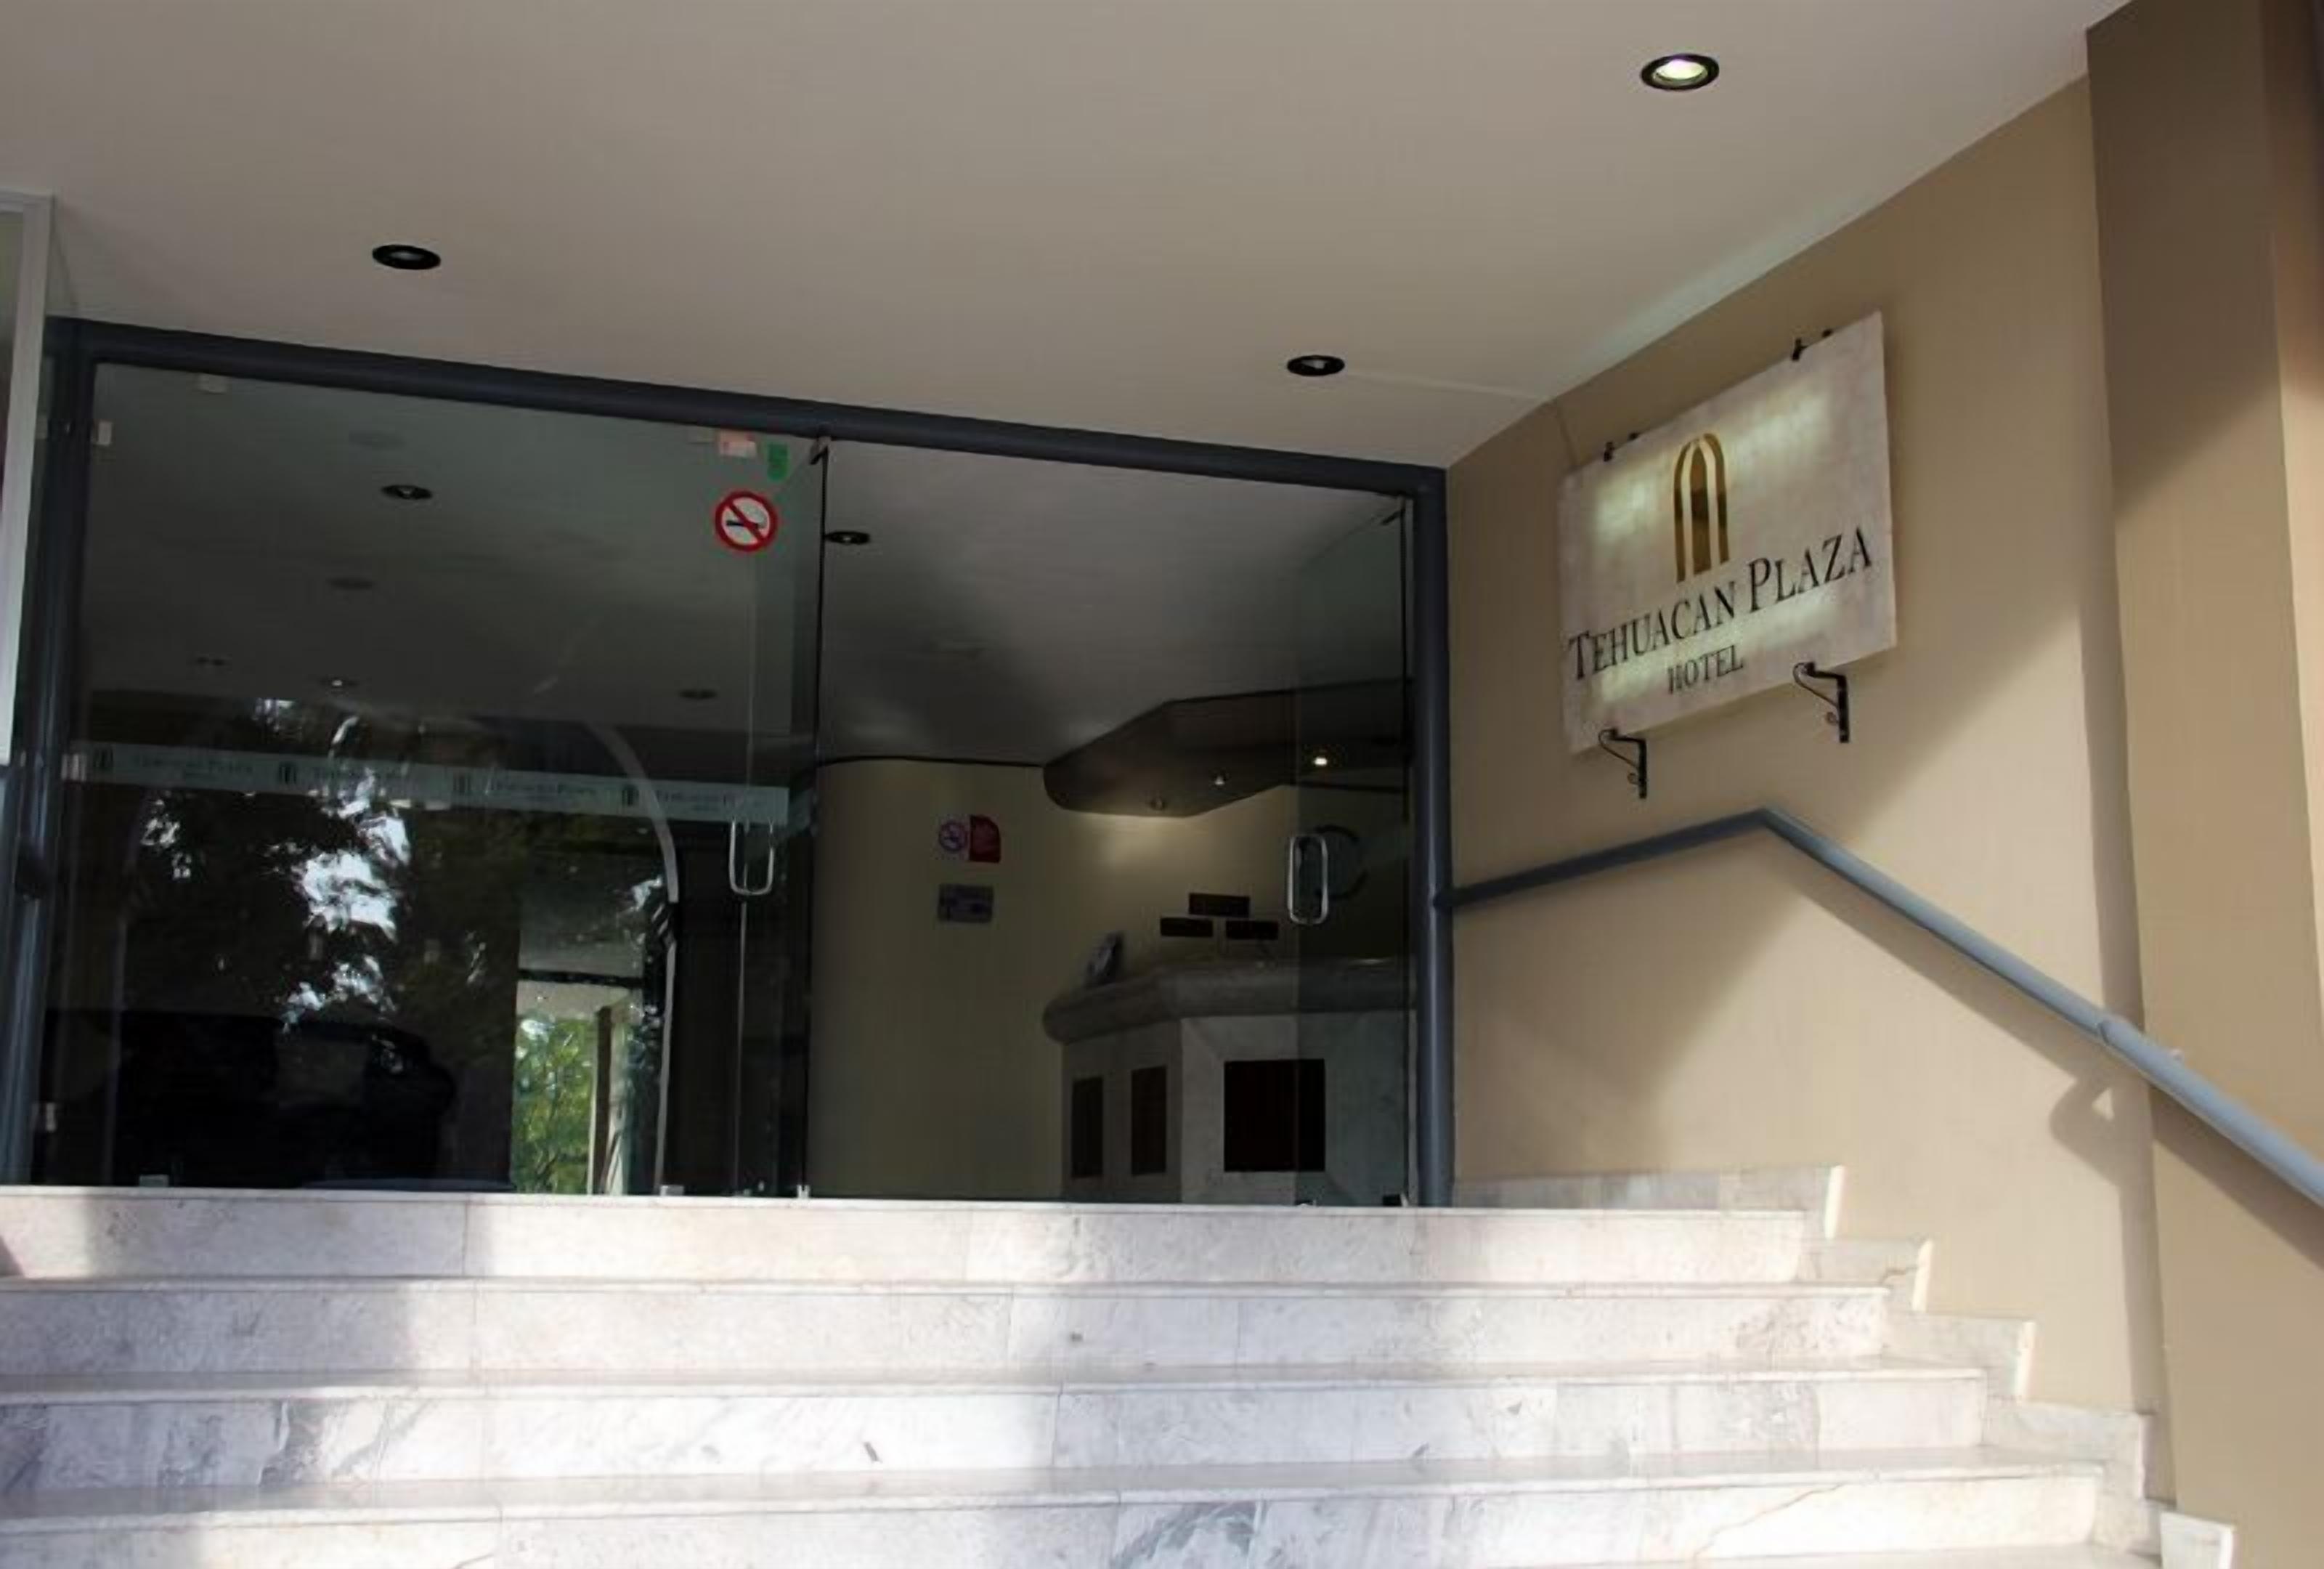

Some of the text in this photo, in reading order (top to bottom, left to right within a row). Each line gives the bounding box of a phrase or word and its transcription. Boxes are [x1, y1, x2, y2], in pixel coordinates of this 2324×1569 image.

[1569, 527, 1872, 679] TEHUACAN PLAZA
[1668, 645, 1744, 694] HOTEL
